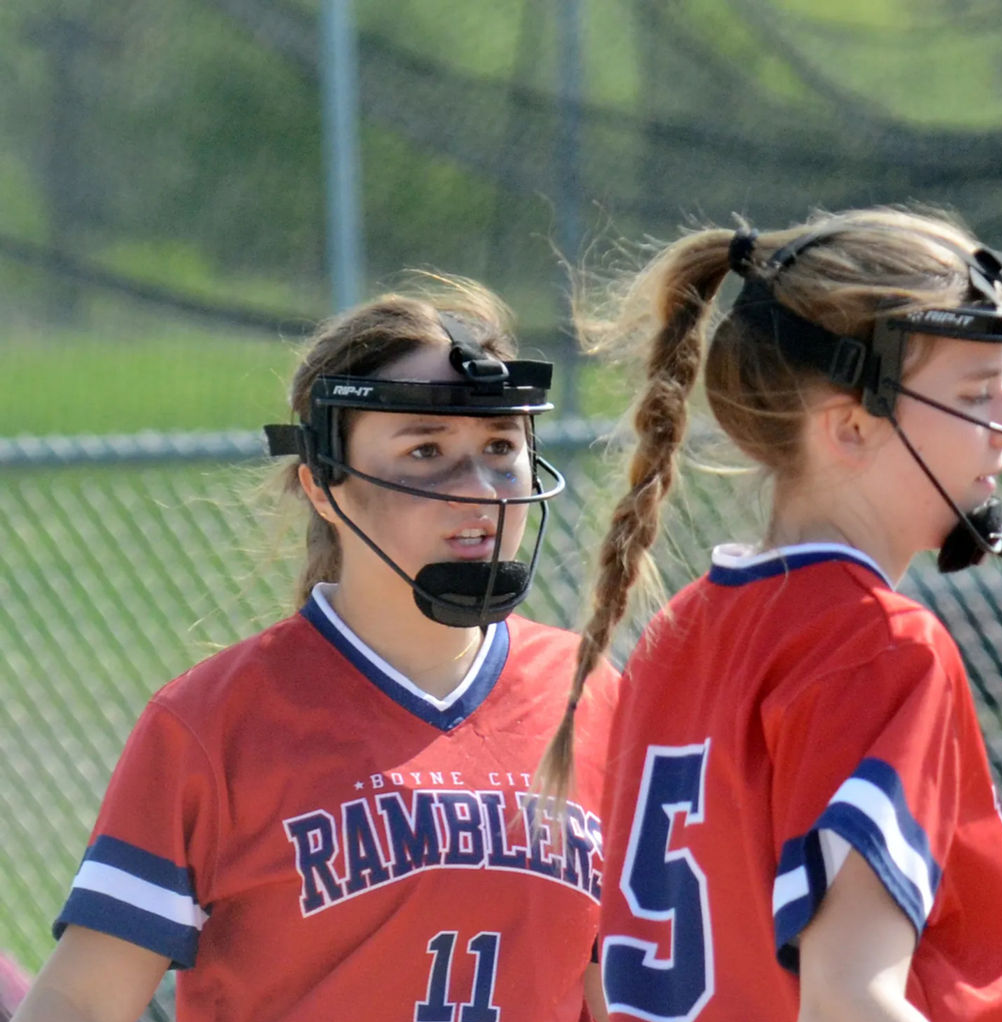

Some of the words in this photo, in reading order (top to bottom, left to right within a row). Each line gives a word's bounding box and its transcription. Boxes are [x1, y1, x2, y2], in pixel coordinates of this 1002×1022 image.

[332, 384, 374, 397] RIP-IT
[370, 771, 464, 789] BOYNE
[488, 772, 531, 788] CIT
